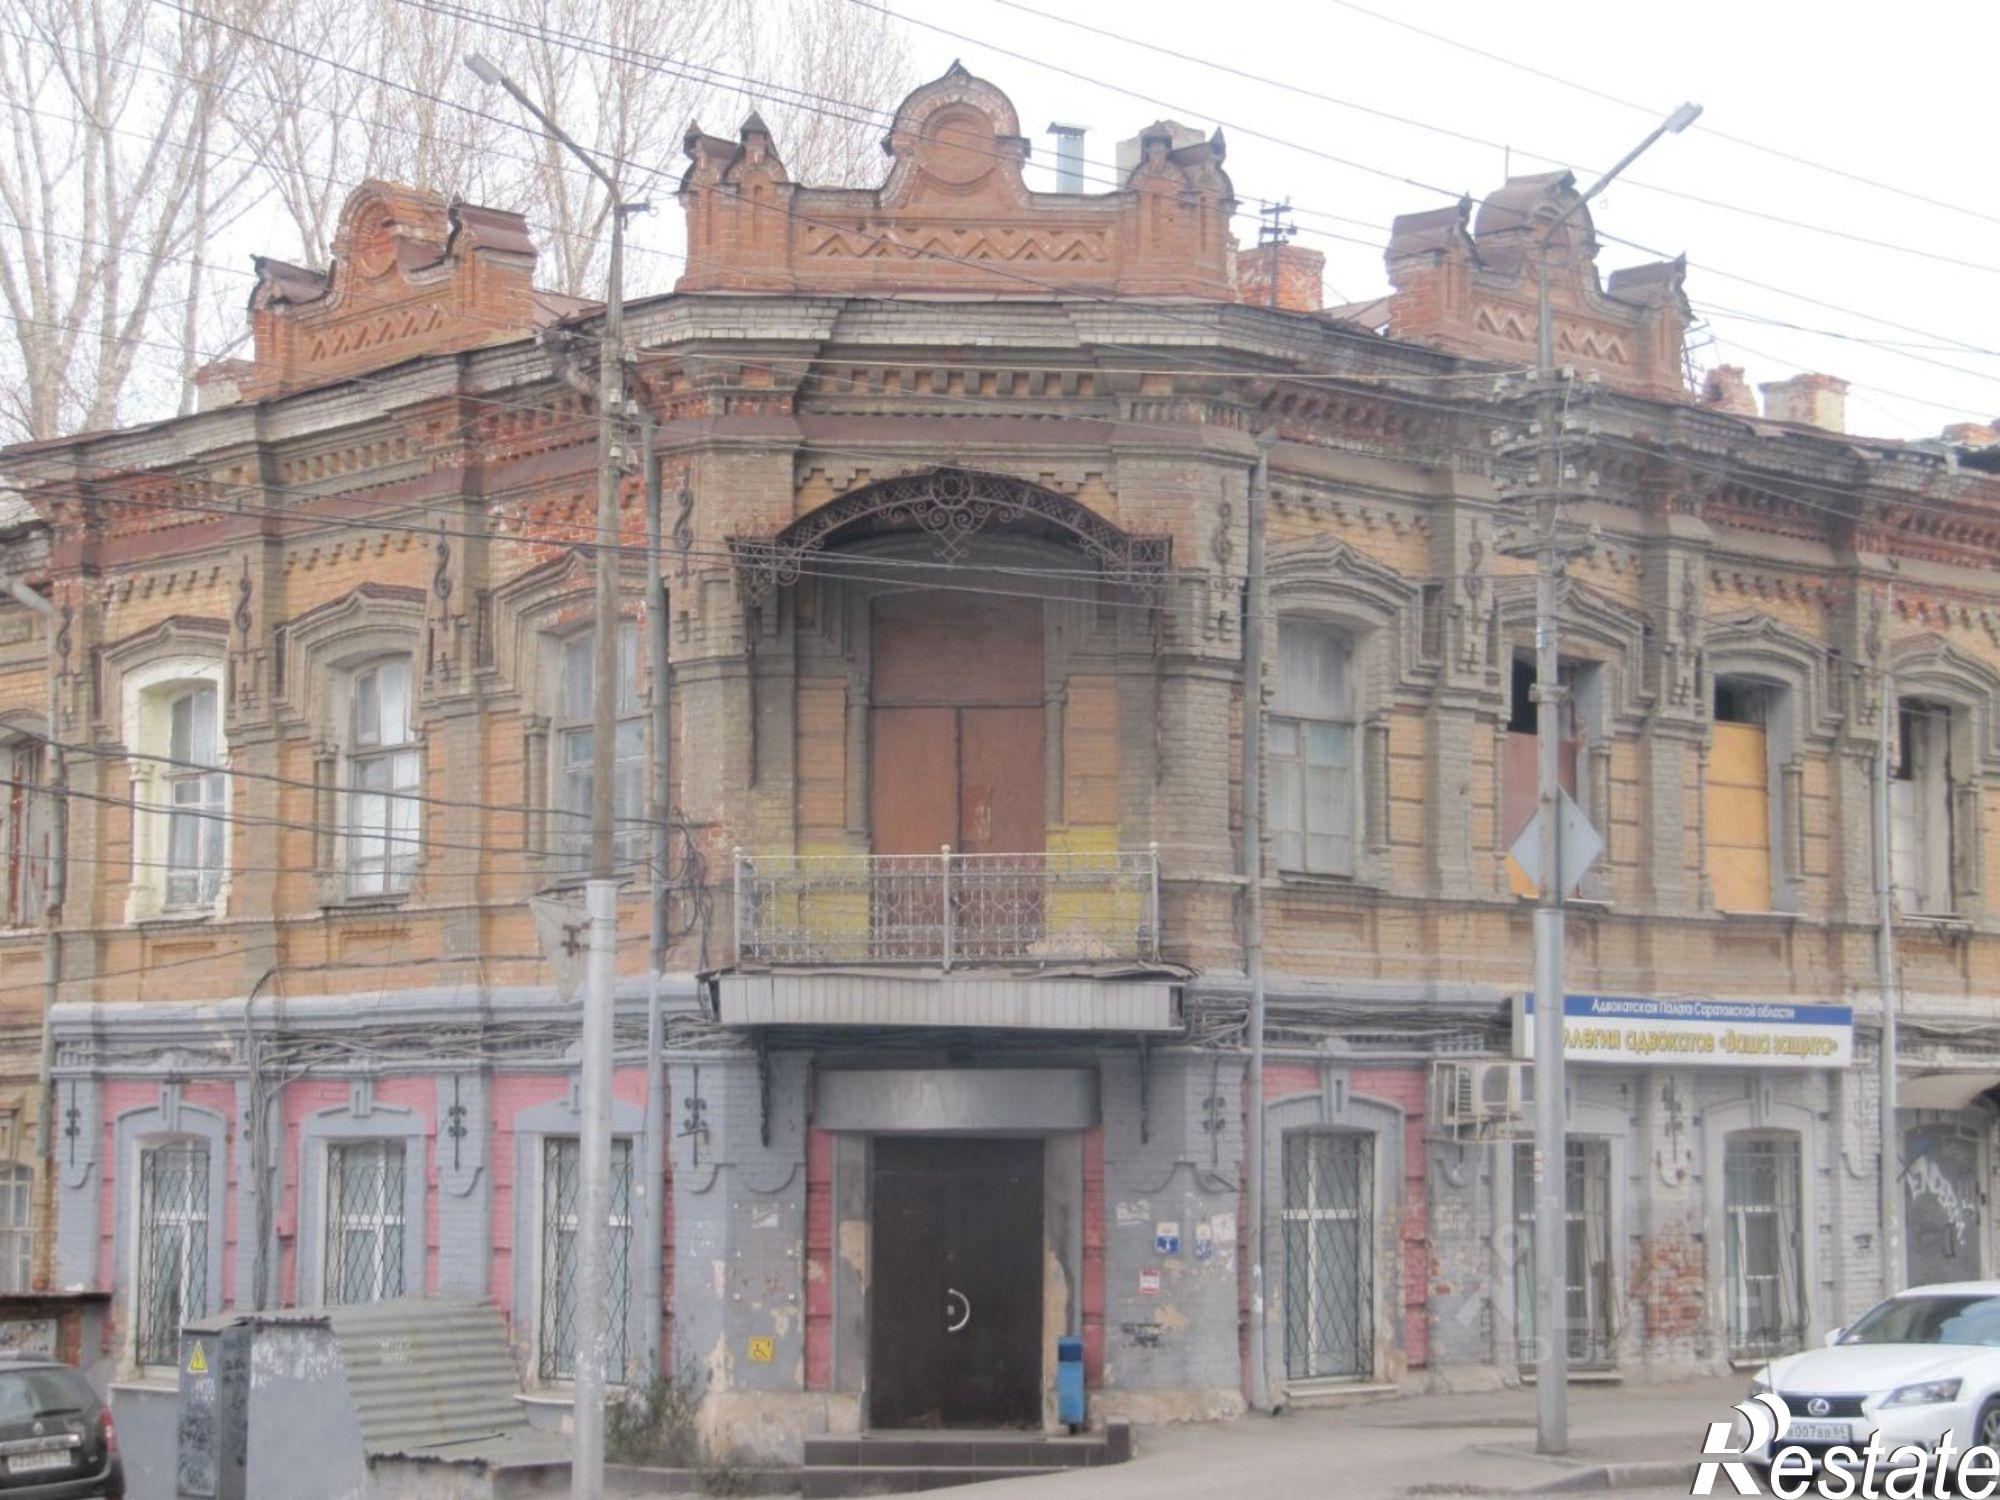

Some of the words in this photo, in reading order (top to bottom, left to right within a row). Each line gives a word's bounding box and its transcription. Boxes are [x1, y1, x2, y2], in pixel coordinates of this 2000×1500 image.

[1591, 998, 1657, 1014] Адвокатская
[1695, 1001, 1755, 1018] Саратовской
[1757, 1004, 1795, 1018] области
[1563, 1027, 1620, 1050] ллегия
[1627, 1030, 1715, 1054] адвокатов
